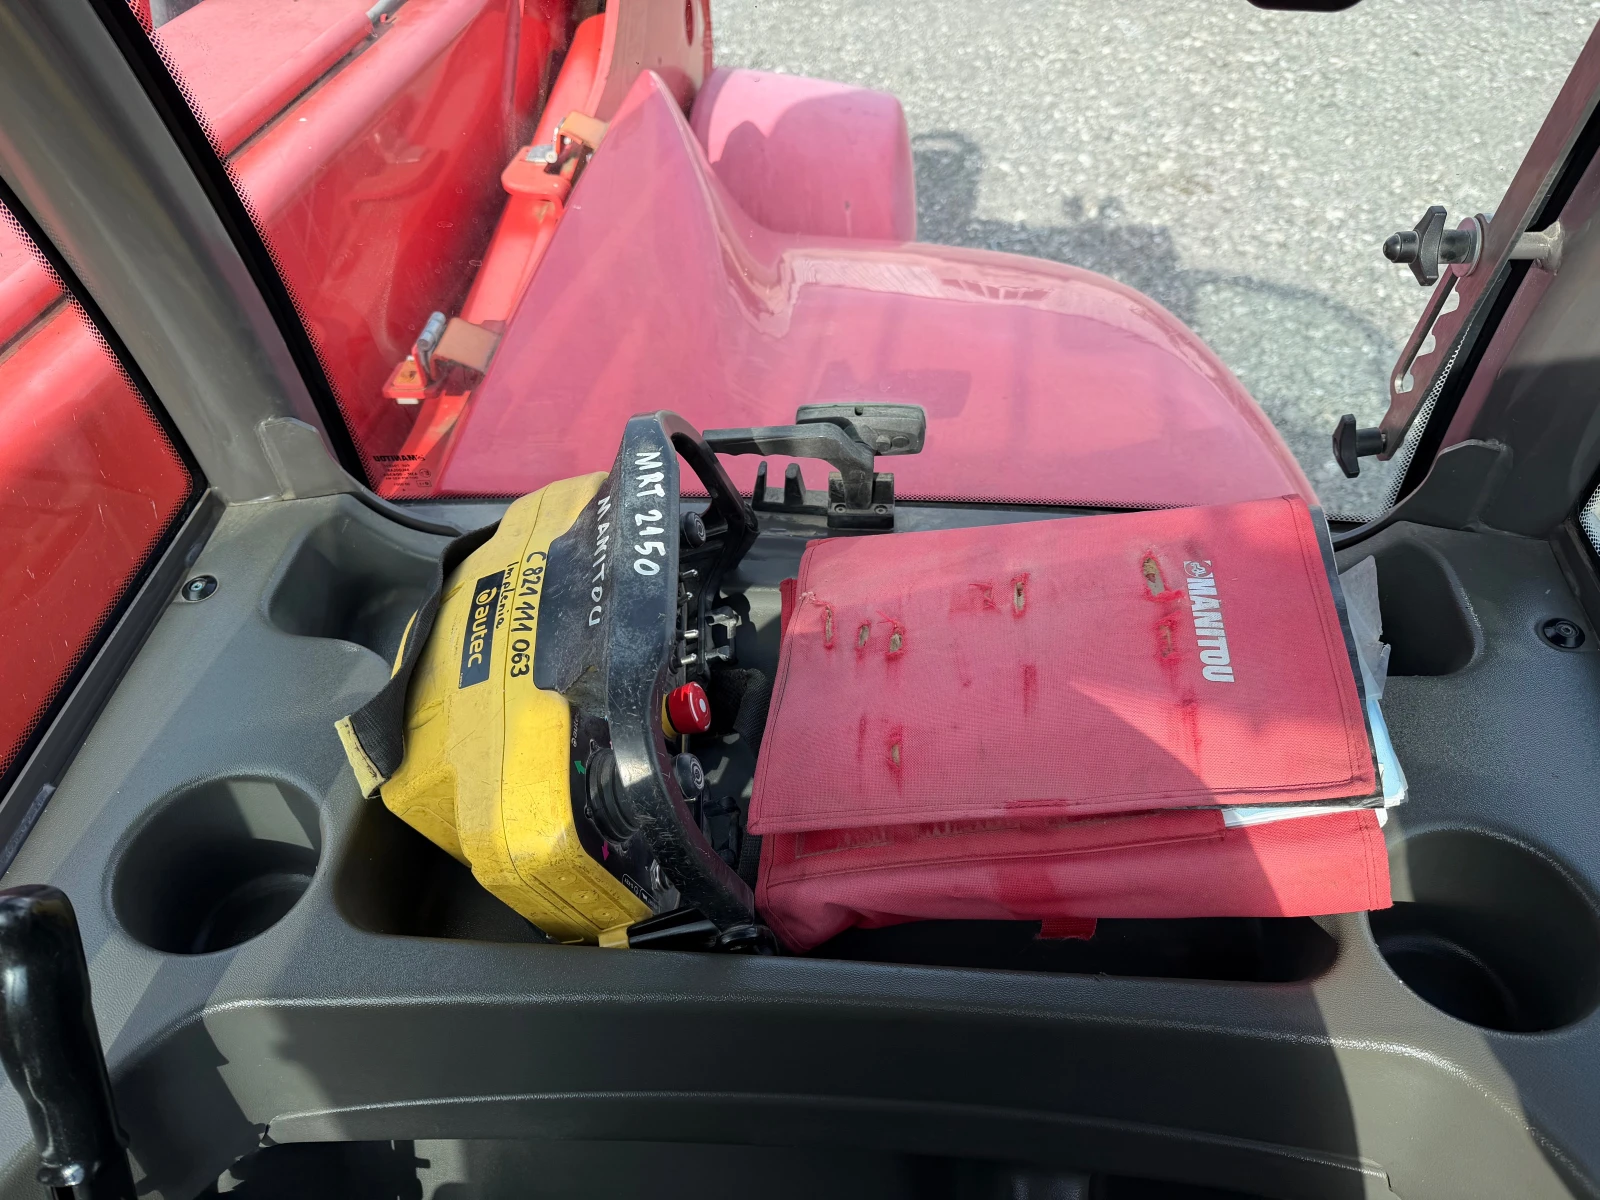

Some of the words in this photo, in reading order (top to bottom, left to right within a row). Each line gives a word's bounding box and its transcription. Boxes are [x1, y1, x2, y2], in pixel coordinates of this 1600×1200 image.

[634, 451, 666, 499] MRT
[525, 551, 547, 564] C
[588, 495, 612, 627] MANITOU
[633, 509, 666, 576] 2150
[520, 566, 544, 597] 821
[468, 604, 491, 668] autec
[510, 601, 536, 633] 111
[1186, 577, 1235, 683] MANITOU
[510, 638, 531, 679] 063
